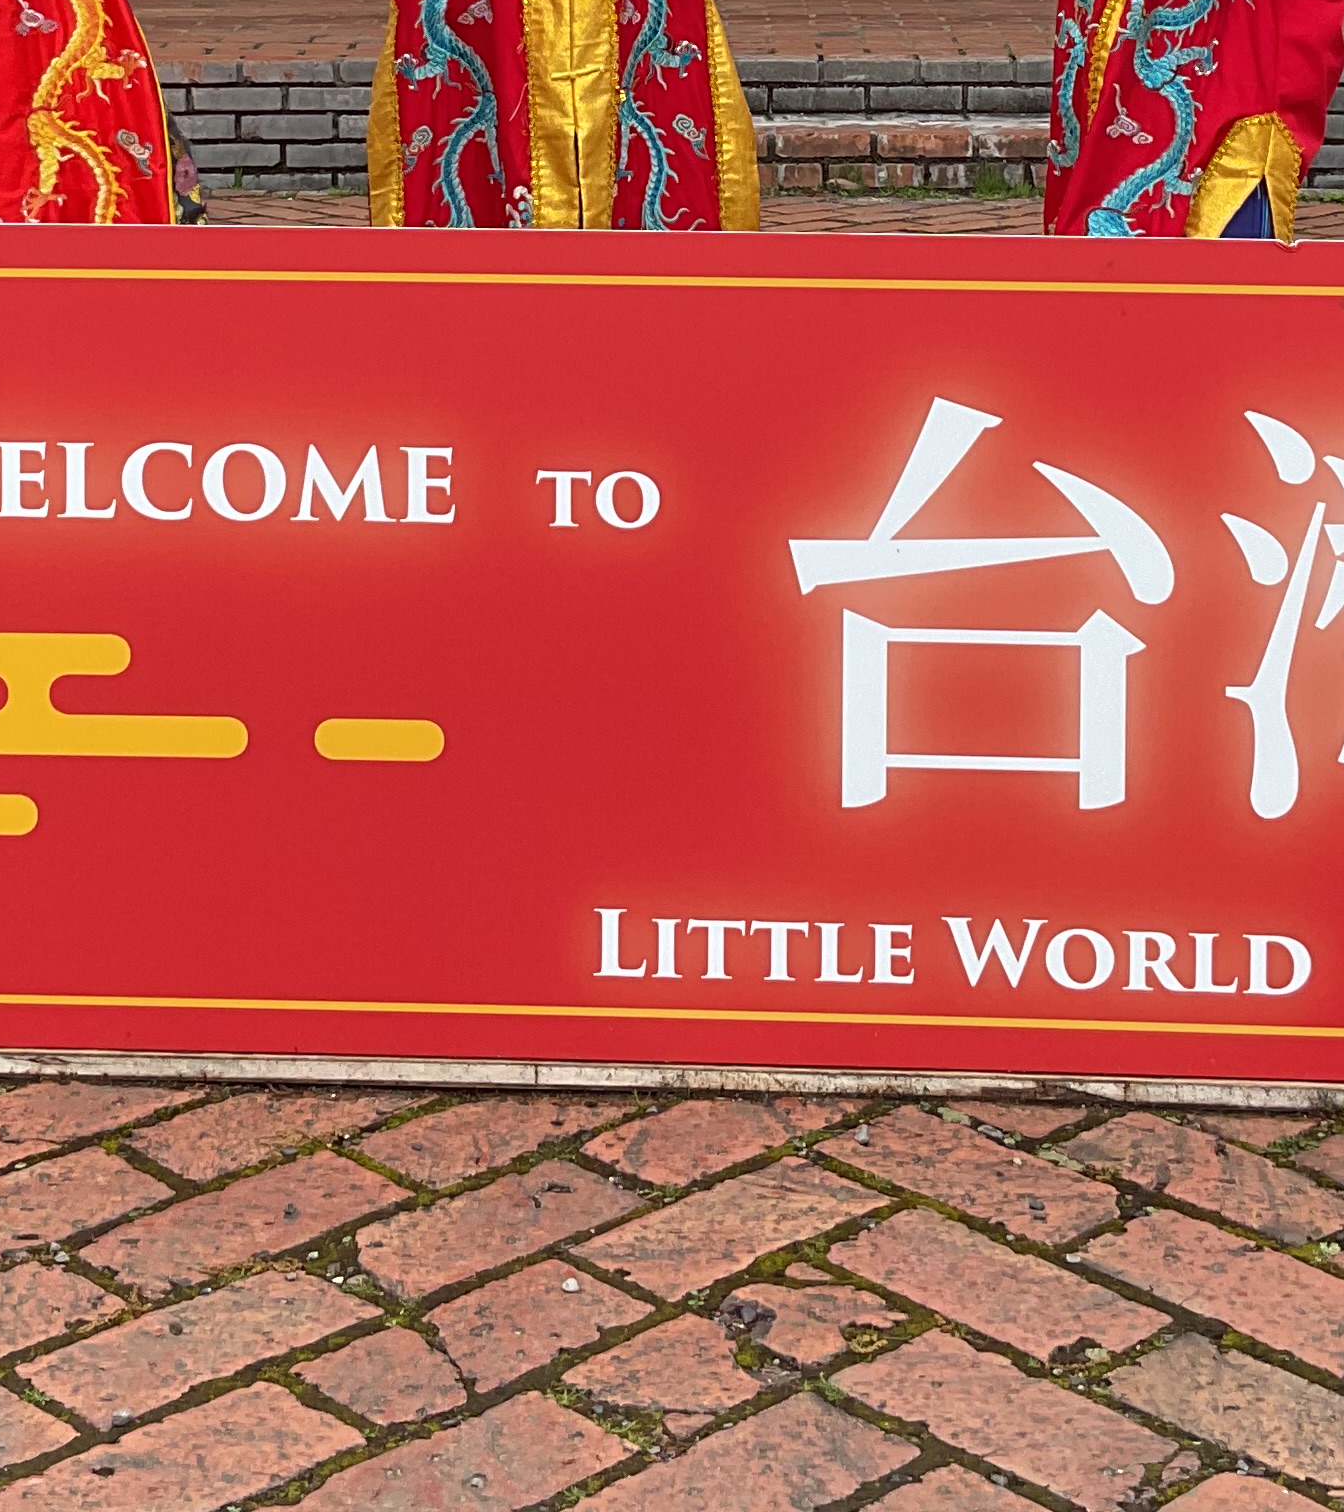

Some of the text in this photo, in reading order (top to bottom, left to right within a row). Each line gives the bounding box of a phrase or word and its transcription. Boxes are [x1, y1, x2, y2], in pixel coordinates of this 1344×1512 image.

[535, 469, 660, 529] TO
[593, 908, 1312, 995] LITTLE WORLD
